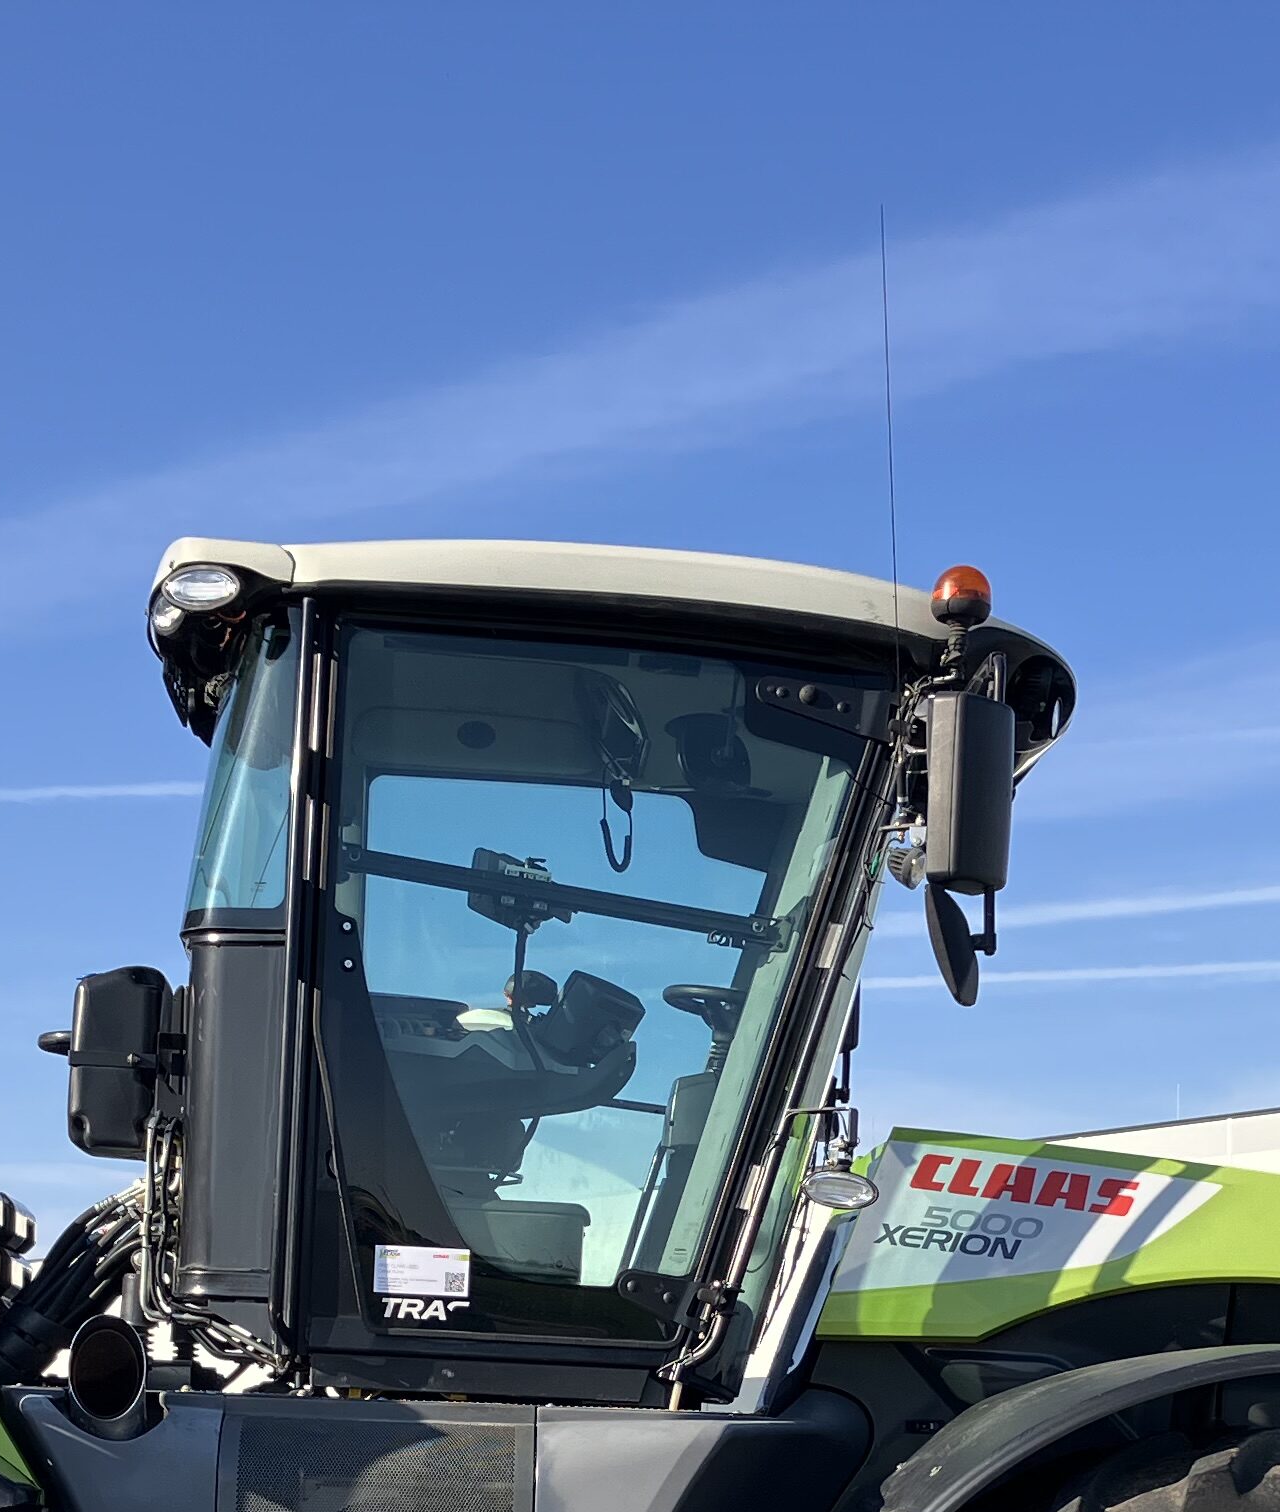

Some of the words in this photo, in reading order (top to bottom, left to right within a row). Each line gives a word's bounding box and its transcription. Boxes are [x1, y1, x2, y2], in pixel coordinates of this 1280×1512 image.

[910, 1153, 1140, 1216] CLAAS
[873, 1222, 1022, 1260] XERION
[920, 1206, 1044, 1240] 5000
